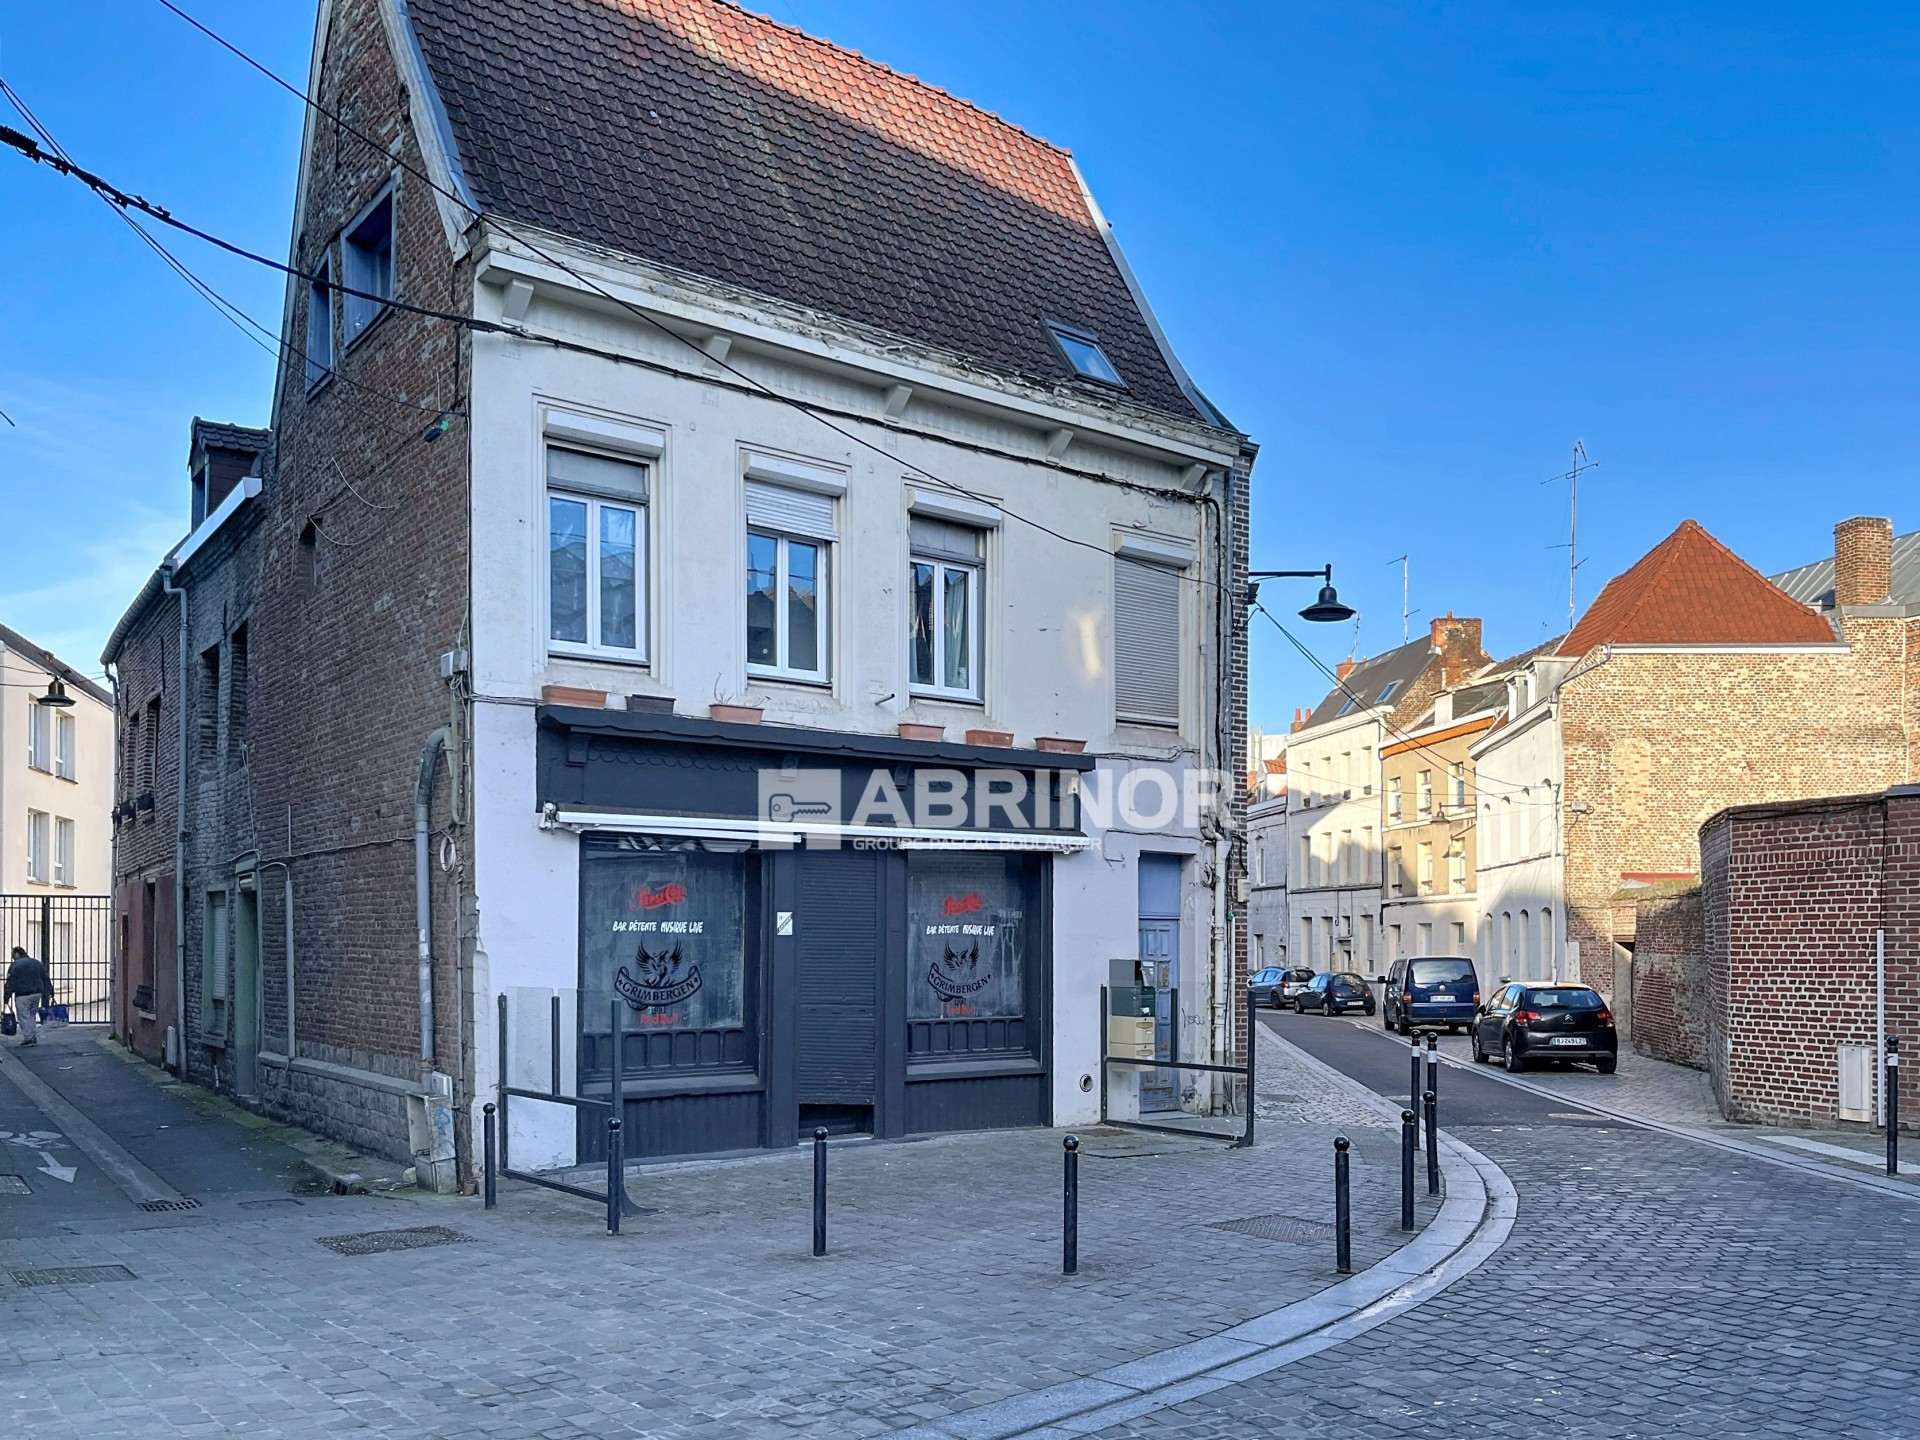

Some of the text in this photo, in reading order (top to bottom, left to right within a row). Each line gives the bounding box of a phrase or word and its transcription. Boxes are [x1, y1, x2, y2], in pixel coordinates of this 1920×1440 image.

[612, 920, 704, 934] BAR DÉTENTE MUSIQUE LIVE
[926, 925, 938, 935] BAR
[622, 980, 695, 1001] GRIMBERGEN
[933, 975, 989, 994] GRIMBERGEN
